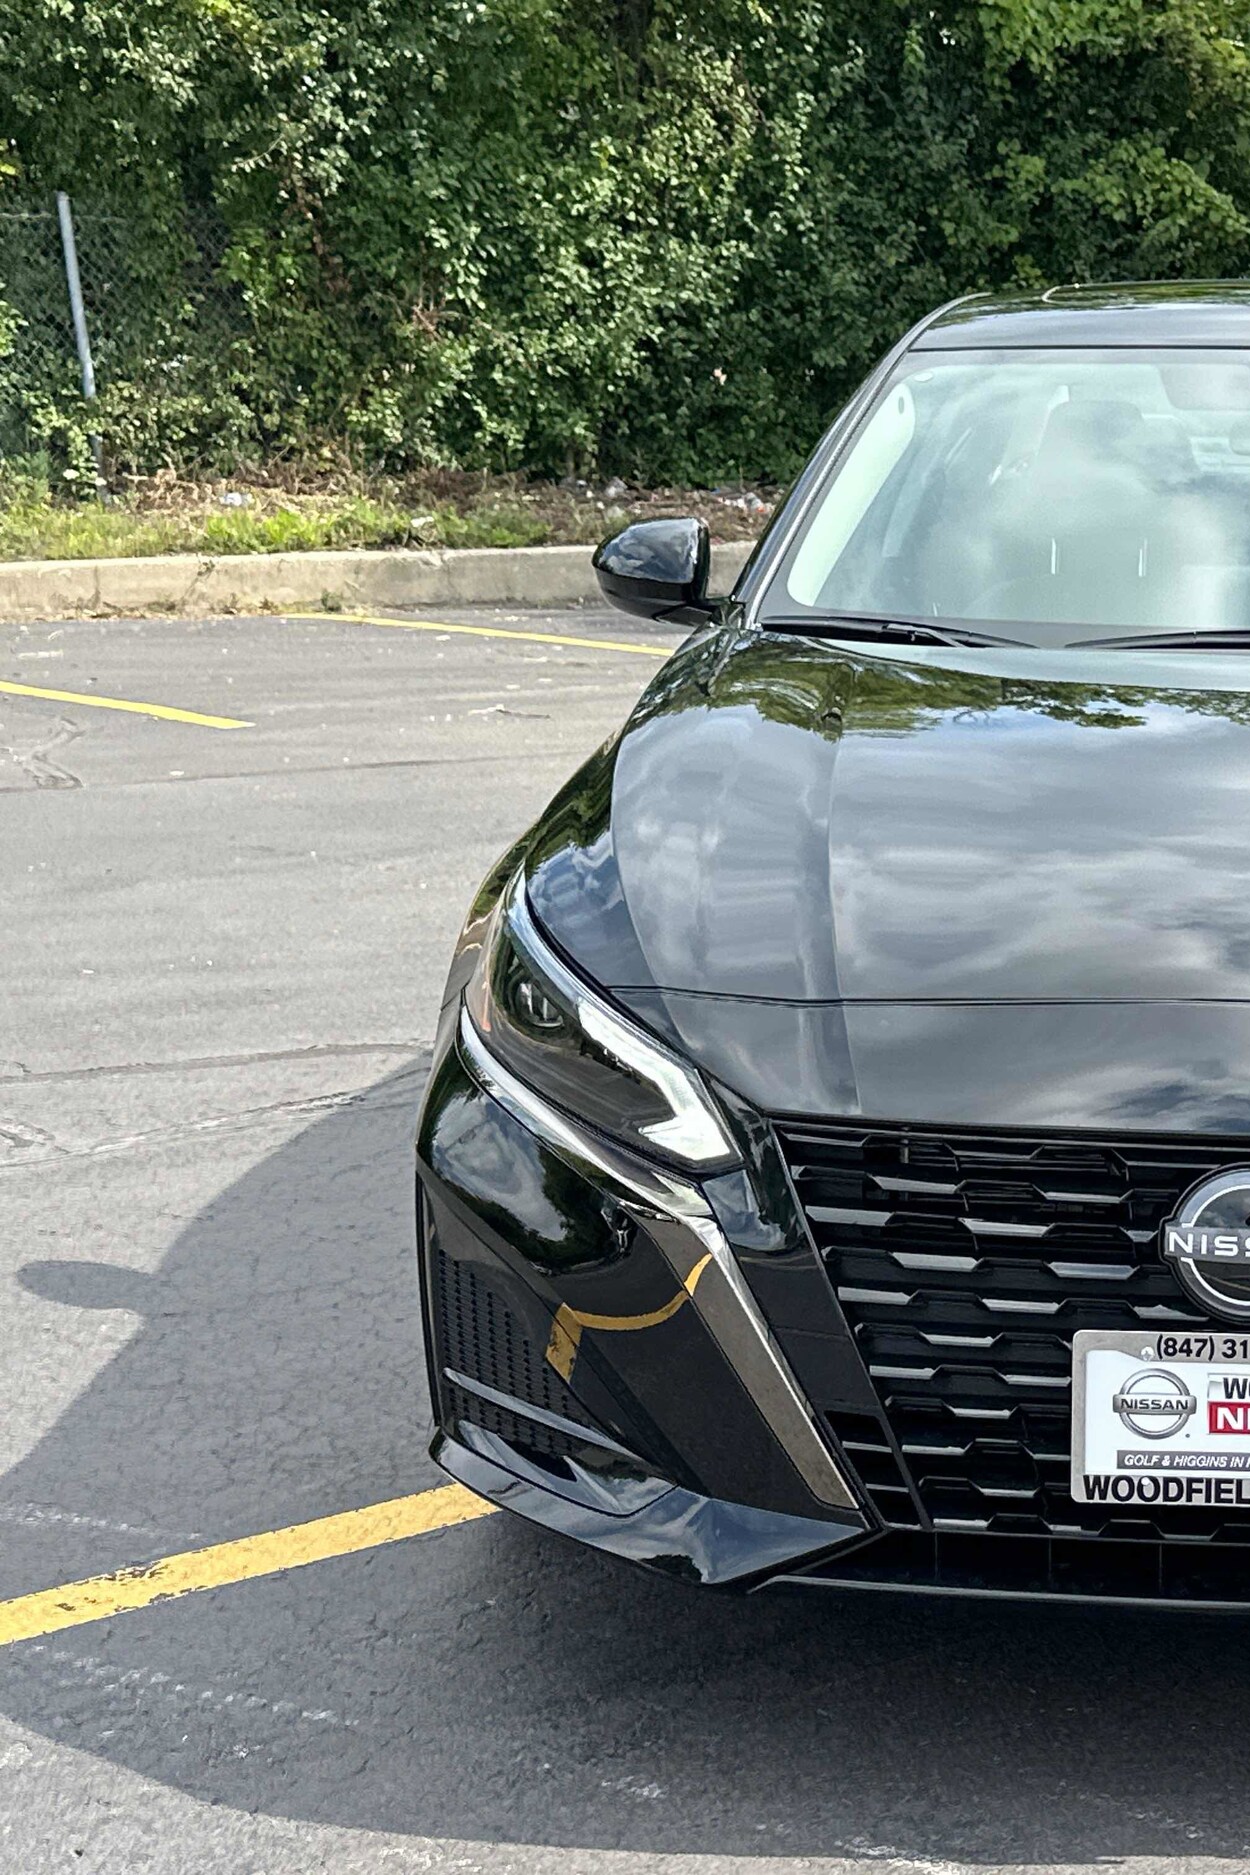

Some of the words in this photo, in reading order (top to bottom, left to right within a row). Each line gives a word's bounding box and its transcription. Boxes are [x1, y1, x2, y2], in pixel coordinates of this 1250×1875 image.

[1156, 1334, 1215, 1362] (847)
[1120, 1398, 1189, 1411] NISSAN
[1124, 1454, 1160, 1467] GOLF
[1162, 1455, 1171, 1467] &
[1173, 1456, 1227, 1468] HIGGINS
[1230, 1457, 1245, 1468] IN
